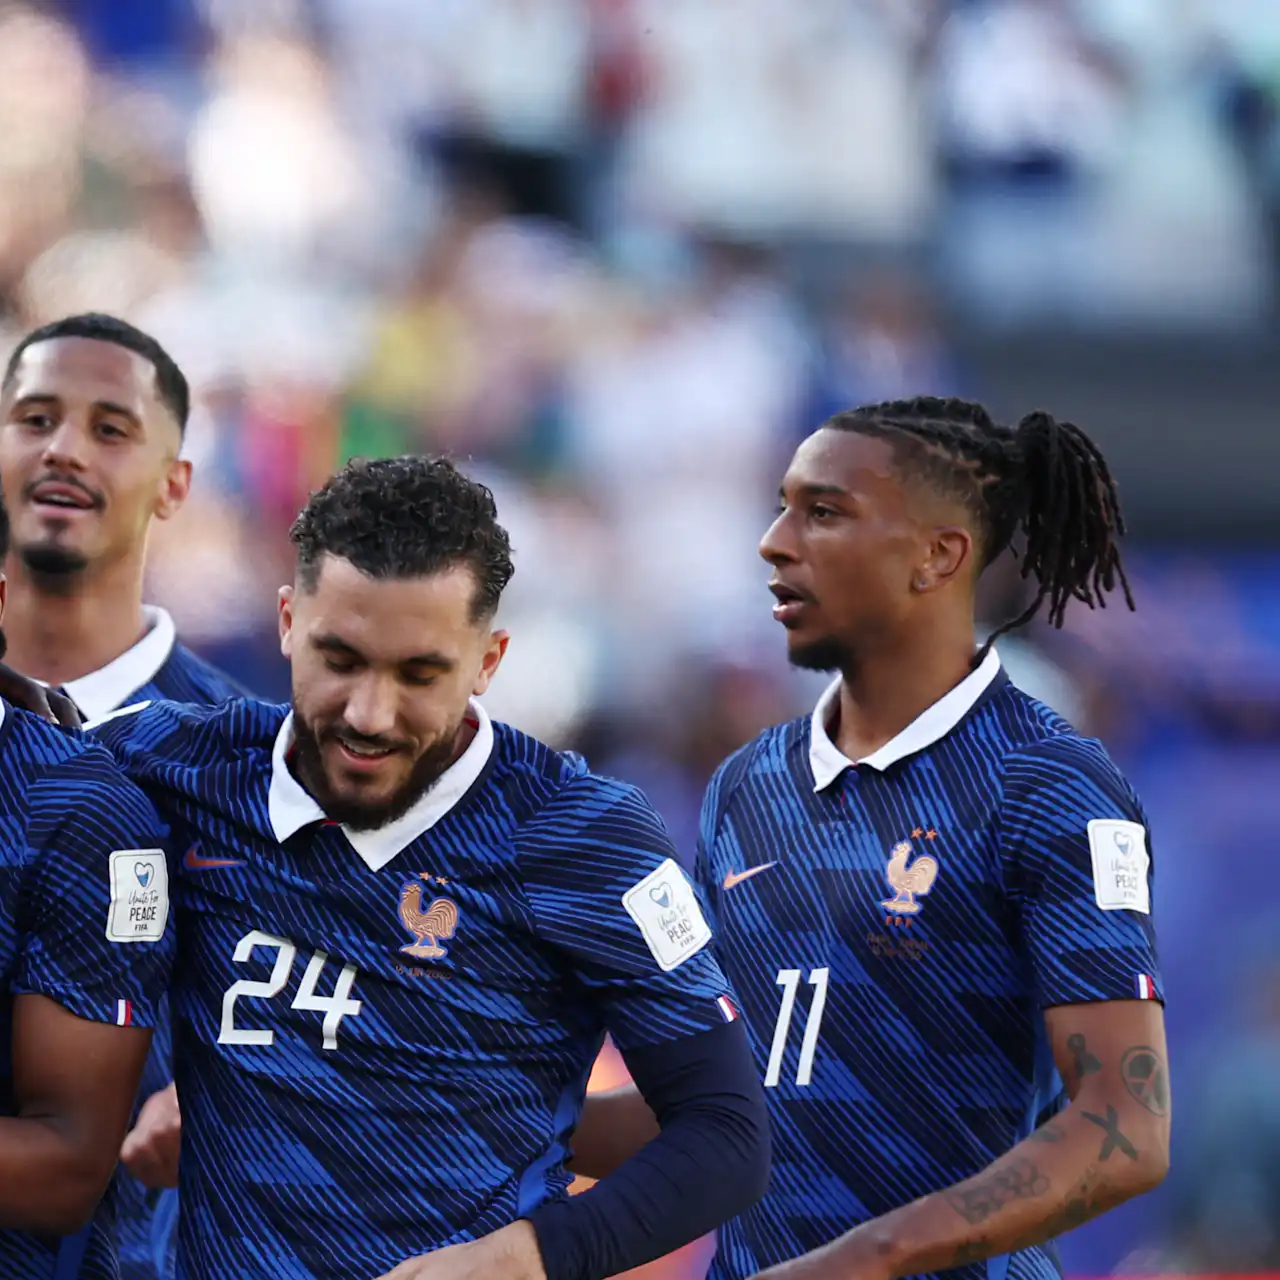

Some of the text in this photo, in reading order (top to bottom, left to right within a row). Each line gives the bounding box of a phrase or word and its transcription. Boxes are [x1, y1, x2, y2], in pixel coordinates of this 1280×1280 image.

[129, 906, 157, 922] PEACE
[134, 923, 148, 932] FIFA
[217, 929, 362, 1050] 24
[763, 967, 829, 1087] 11
